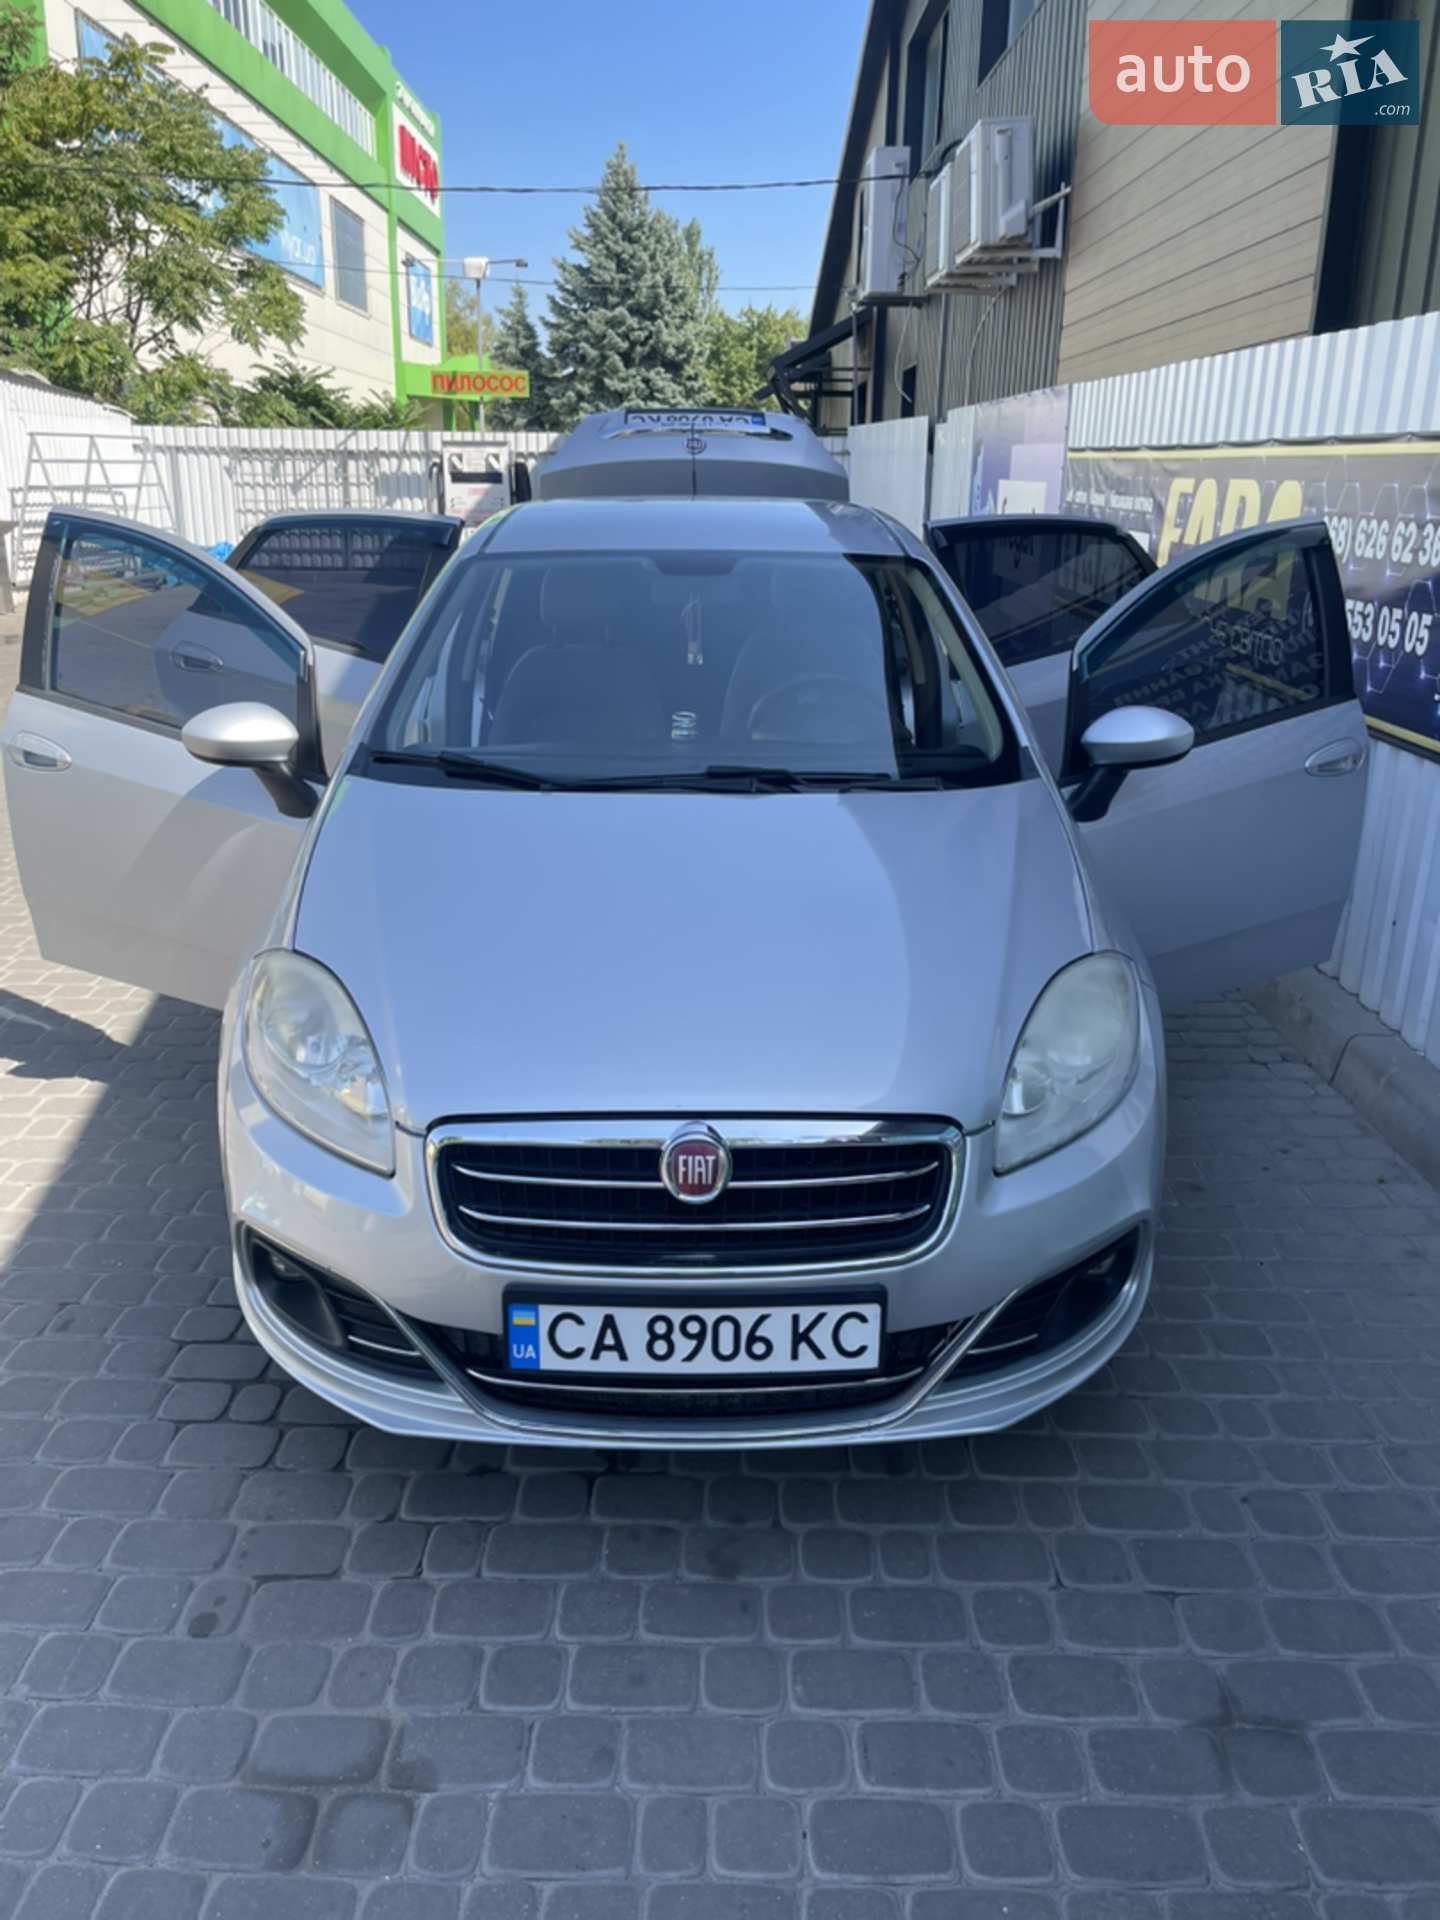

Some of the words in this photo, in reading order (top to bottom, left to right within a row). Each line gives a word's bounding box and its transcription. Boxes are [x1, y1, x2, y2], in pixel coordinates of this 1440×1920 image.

[431, 373, 527, 394] ПИЛОСОС
[1355, 518, 1389, 560] 626
[1391, 521, 1417, 564] 62
[1377, 606, 1402, 649] 05
[1404, 611, 1432, 656] 05
[678, 1154, 716, 1185] FIAT
[513, 1344, 537, 1359] UA
[547, 1312, 628, 1362] CA
[645, 1315, 774, 1363] 8906
[790, 1311, 869, 1361] KC
